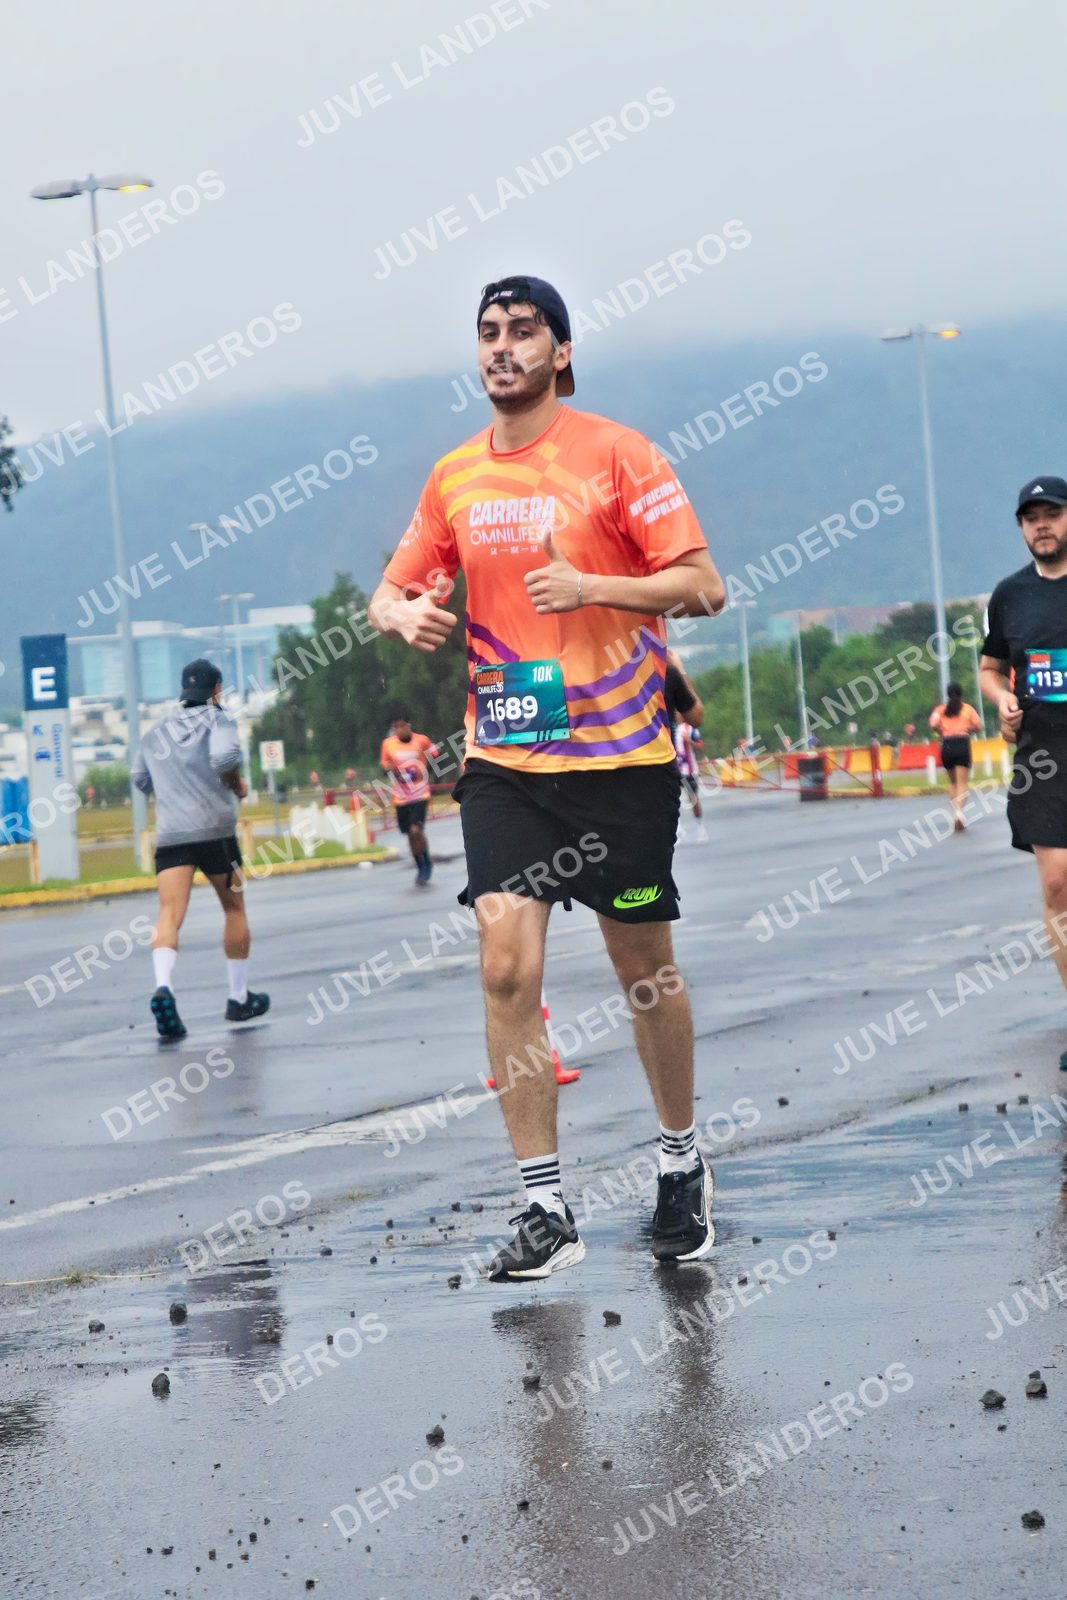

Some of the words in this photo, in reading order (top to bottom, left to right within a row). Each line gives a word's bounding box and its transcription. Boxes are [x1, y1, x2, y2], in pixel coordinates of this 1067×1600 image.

[469, 496, 555, 527] CARRERA
[32, 666, 57, 701] E
[532, 666, 553, 682] 10K
[487, 695, 538, 721] 1689
[622, 885, 658, 900] RUN
